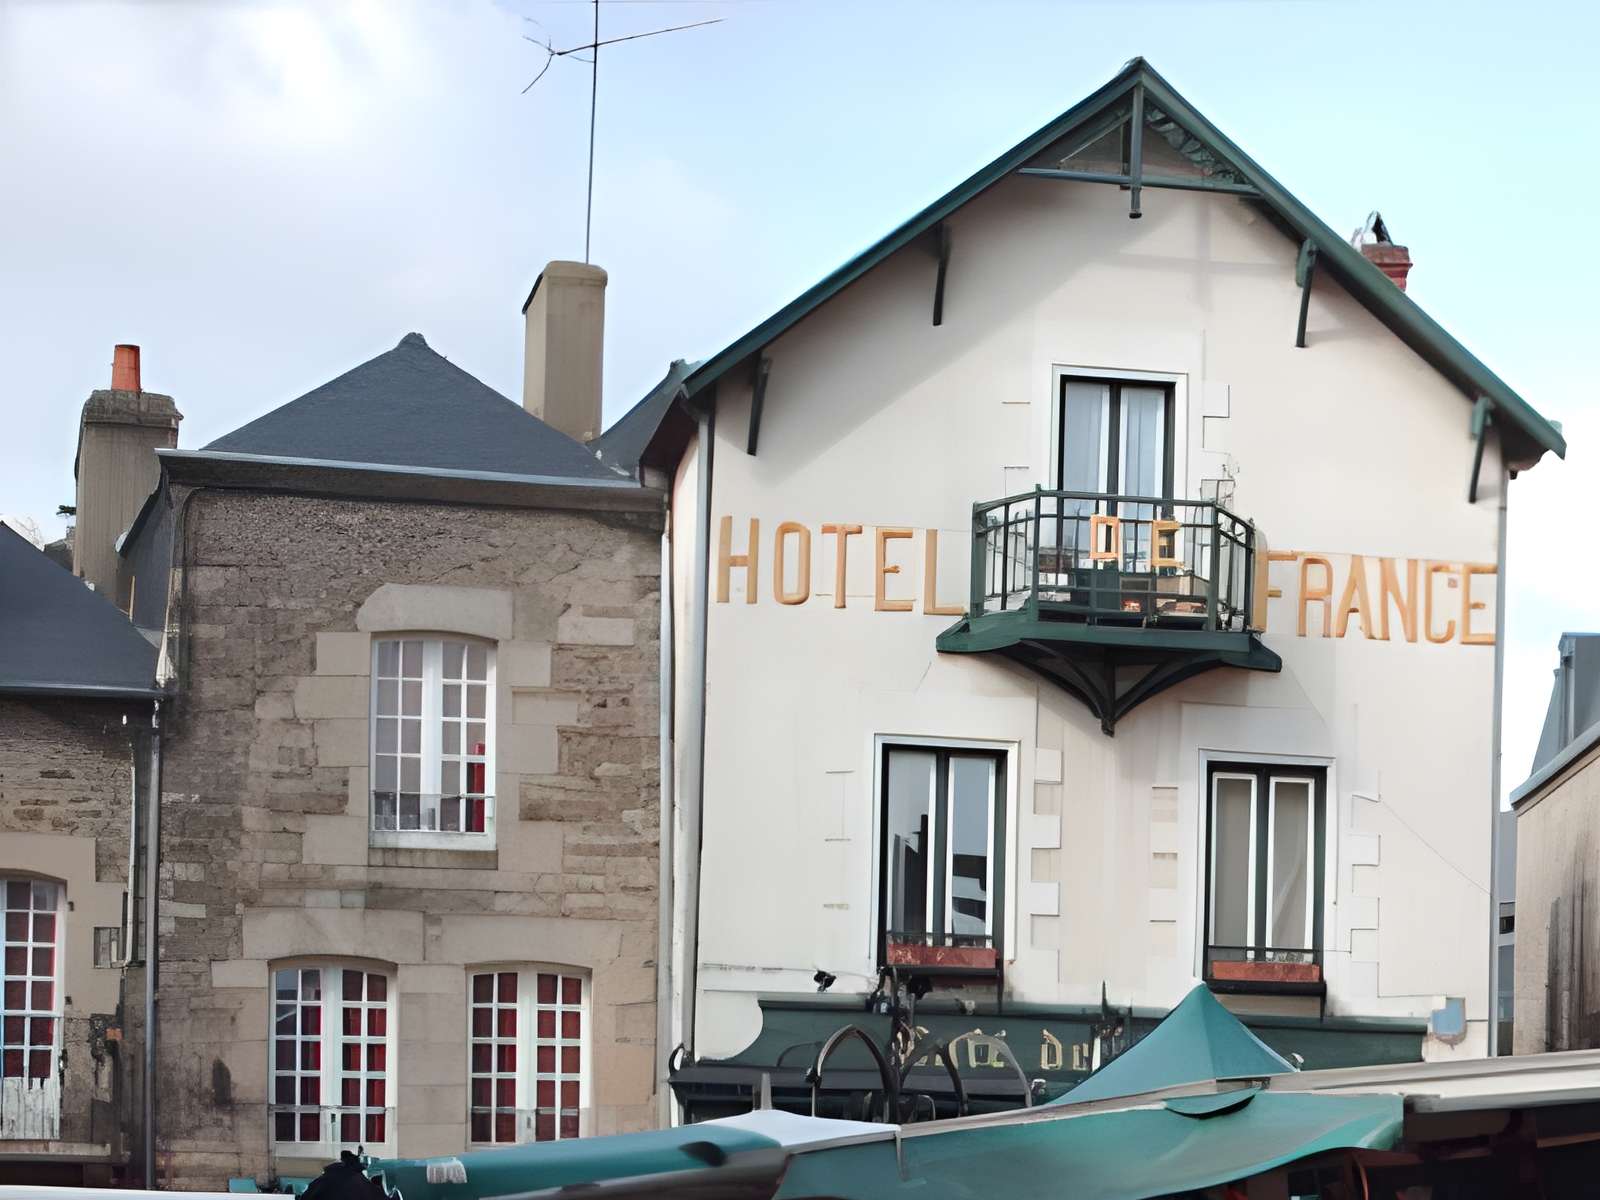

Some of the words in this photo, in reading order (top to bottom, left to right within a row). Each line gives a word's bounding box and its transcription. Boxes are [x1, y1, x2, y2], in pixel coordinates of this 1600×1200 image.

[716, 514, 967, 616] HOTEL
[1089, 513, 1184, 568] DE
[1252, 549, 1498, 646] FRANCE
